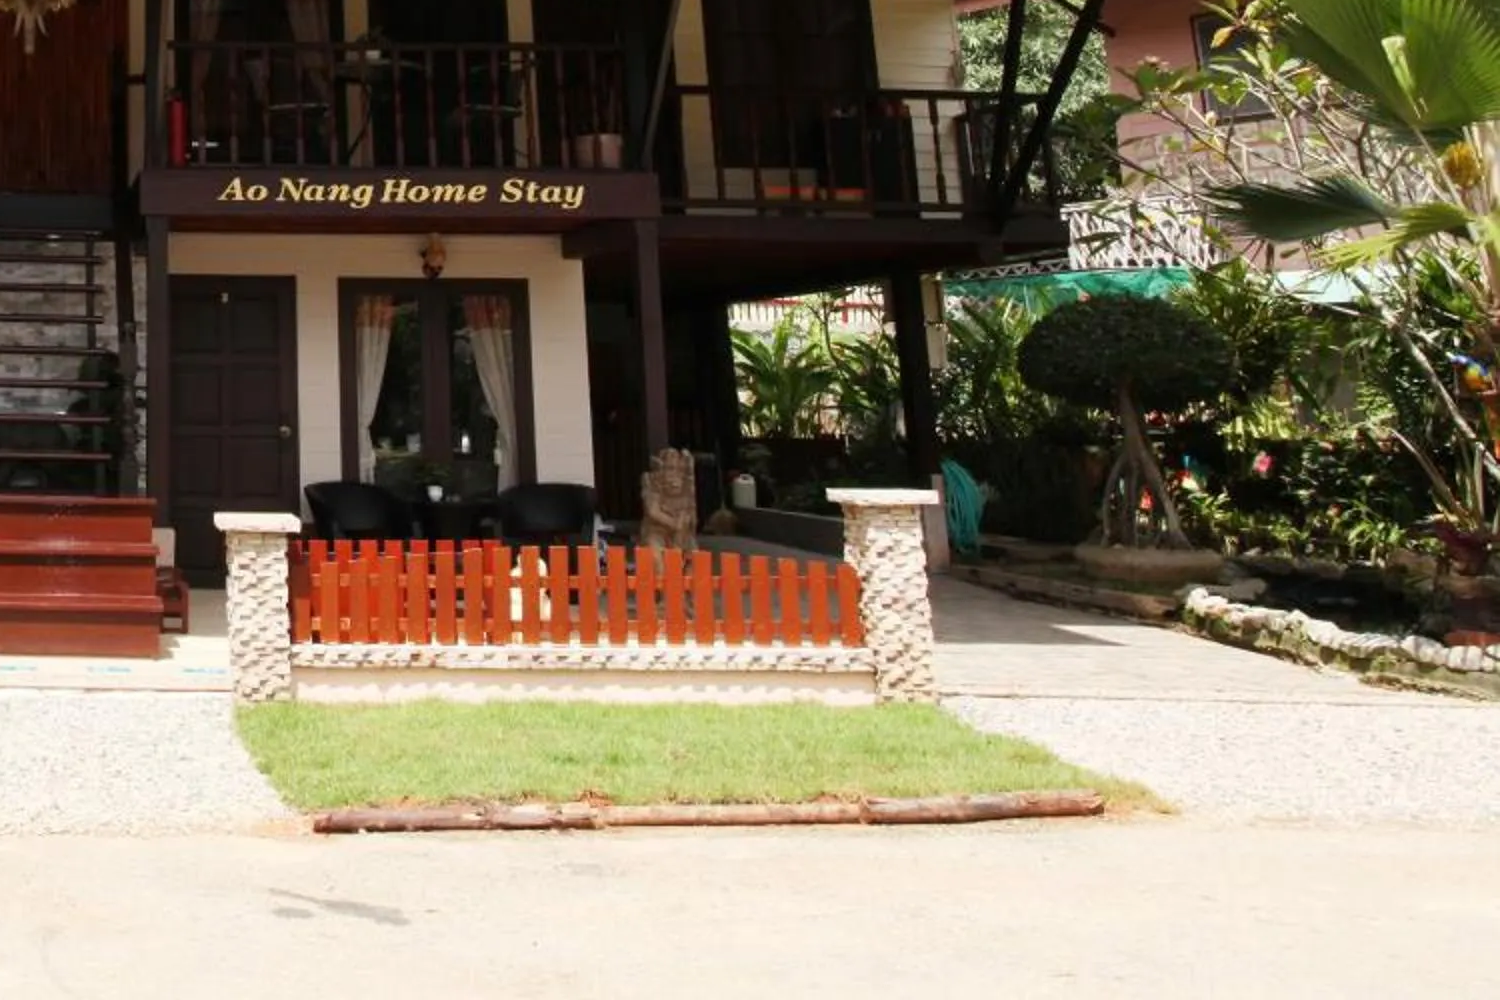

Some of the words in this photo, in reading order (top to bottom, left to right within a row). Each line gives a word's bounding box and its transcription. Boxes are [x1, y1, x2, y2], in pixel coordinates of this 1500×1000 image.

[217, 177, 269, 201] Ao
[275, 177, 375, 209] Nang
[379, 178, 488, 204] Home
[499, 178, 585, 210] Stay
